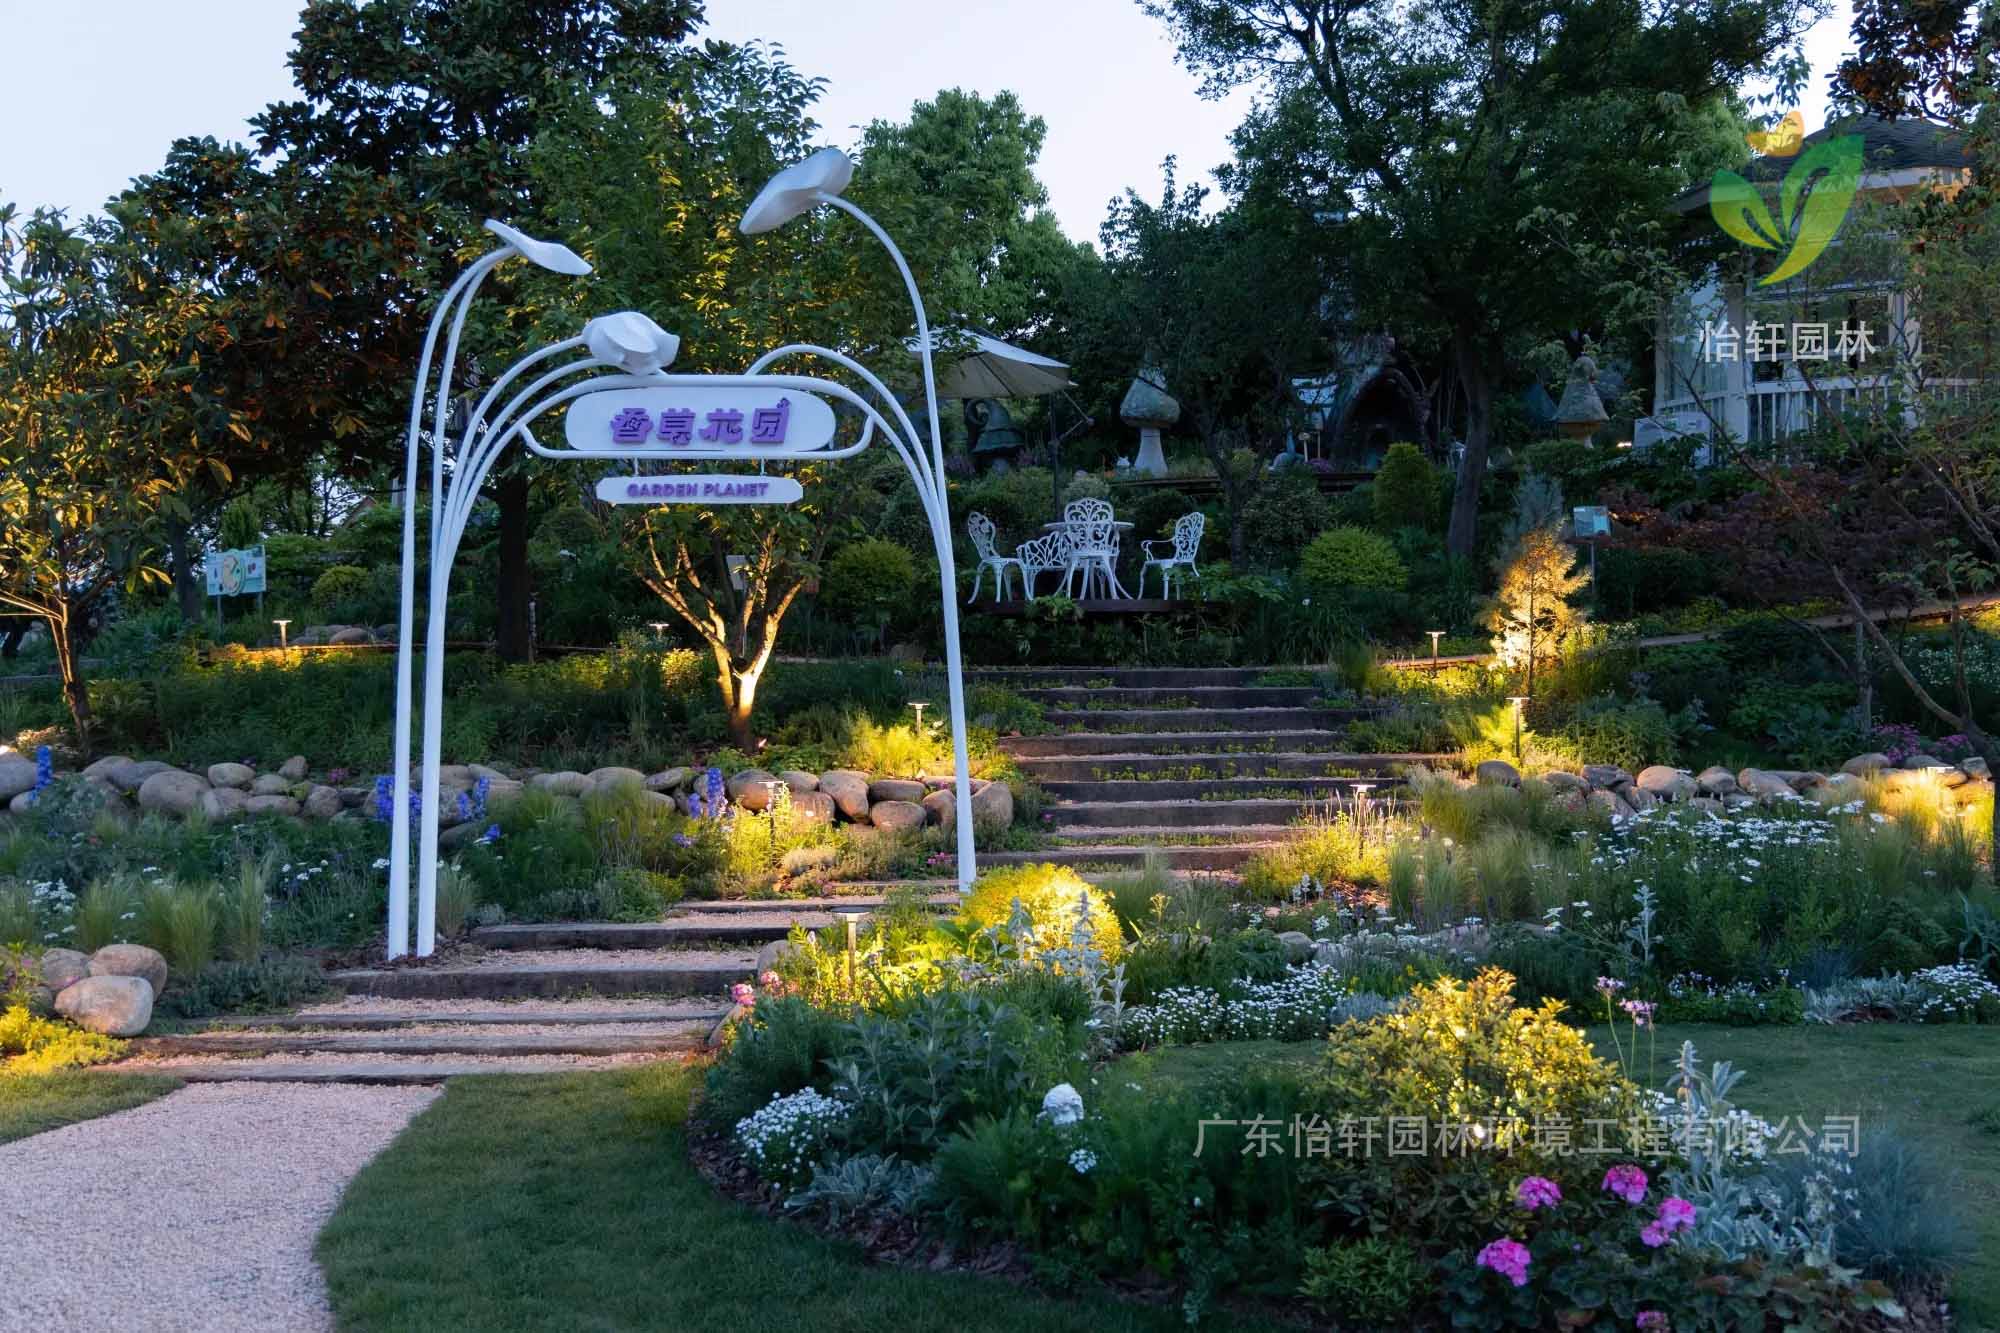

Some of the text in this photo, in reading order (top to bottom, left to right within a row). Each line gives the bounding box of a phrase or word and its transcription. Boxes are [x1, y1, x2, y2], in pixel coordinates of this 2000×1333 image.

[611, 398, 791, 445] 香草花园
[626, 482, 769, 498] GARDEN PLANET
